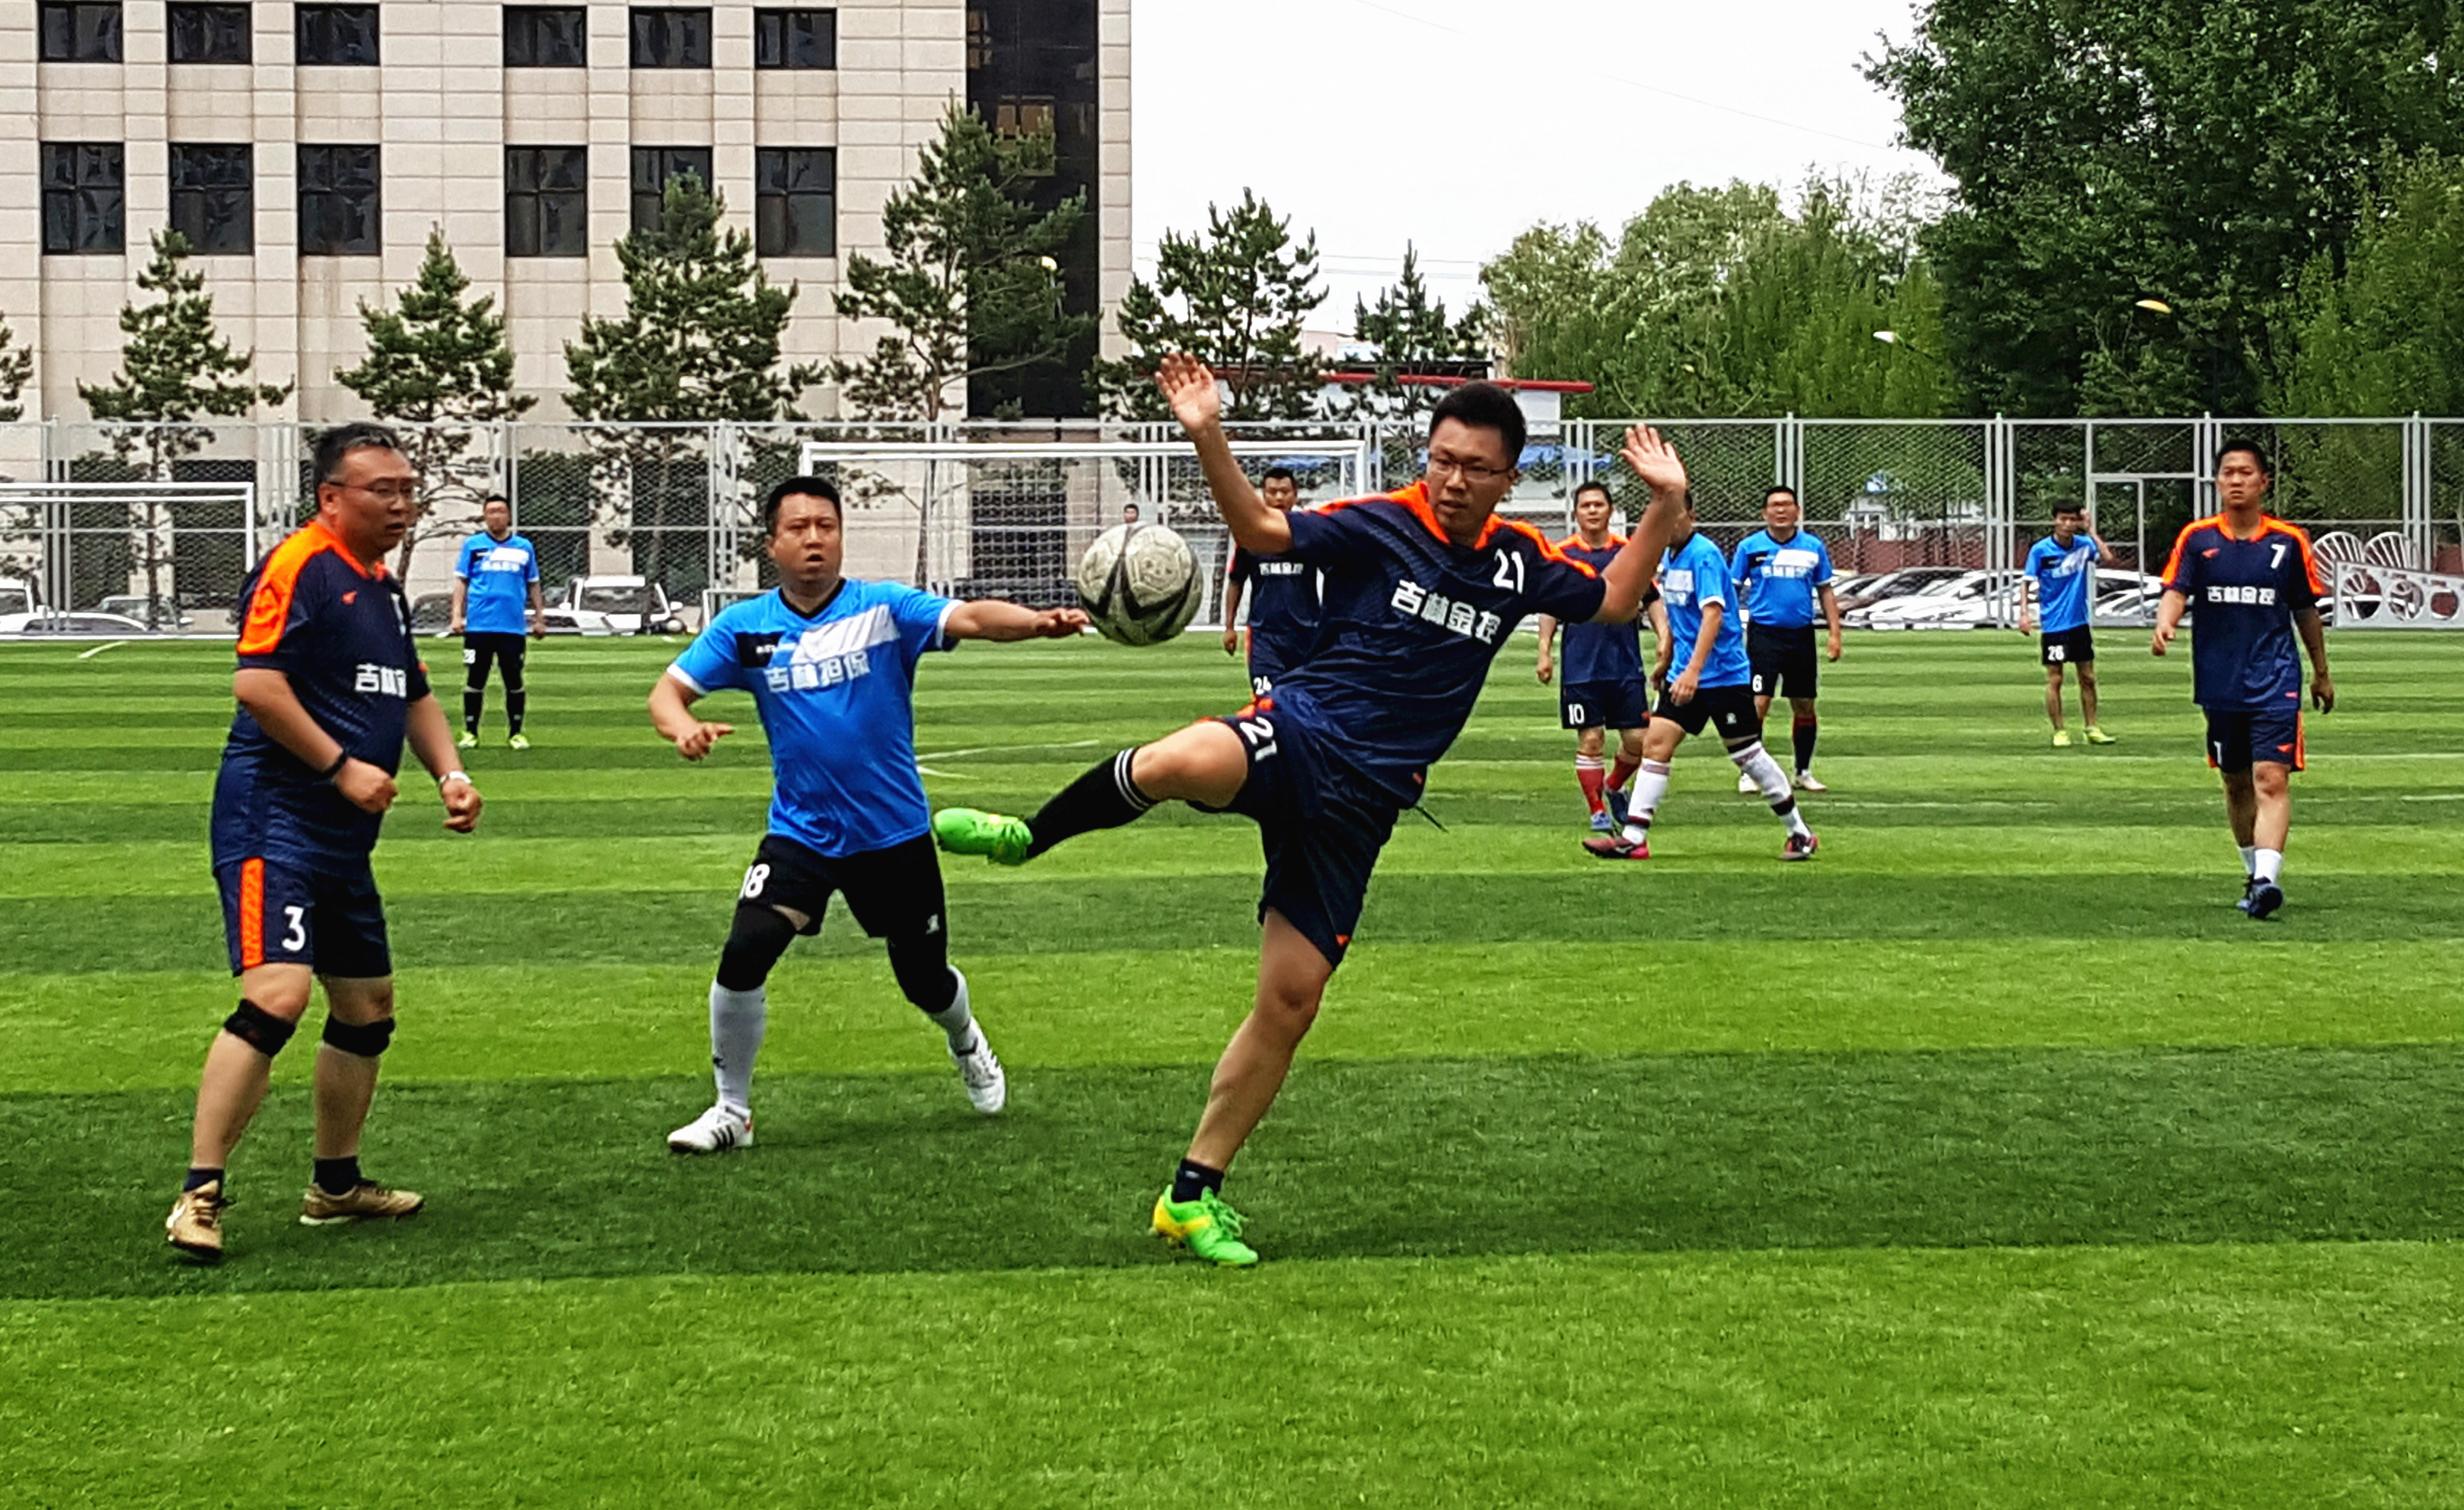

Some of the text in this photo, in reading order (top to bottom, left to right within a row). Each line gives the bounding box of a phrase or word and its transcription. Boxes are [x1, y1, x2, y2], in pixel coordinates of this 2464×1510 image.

[1493, 548, 1524, 594] 21
[2271, 544, 2285, 569] 7
[1391, 579, 1501, 645] 吉林金控
[763, 649, 870, 692] 吉林担保
[1568, 703, 1585, 725] 10
[1240, 716, 1277, 762] 21
[282, 905, 305, 951] 3
